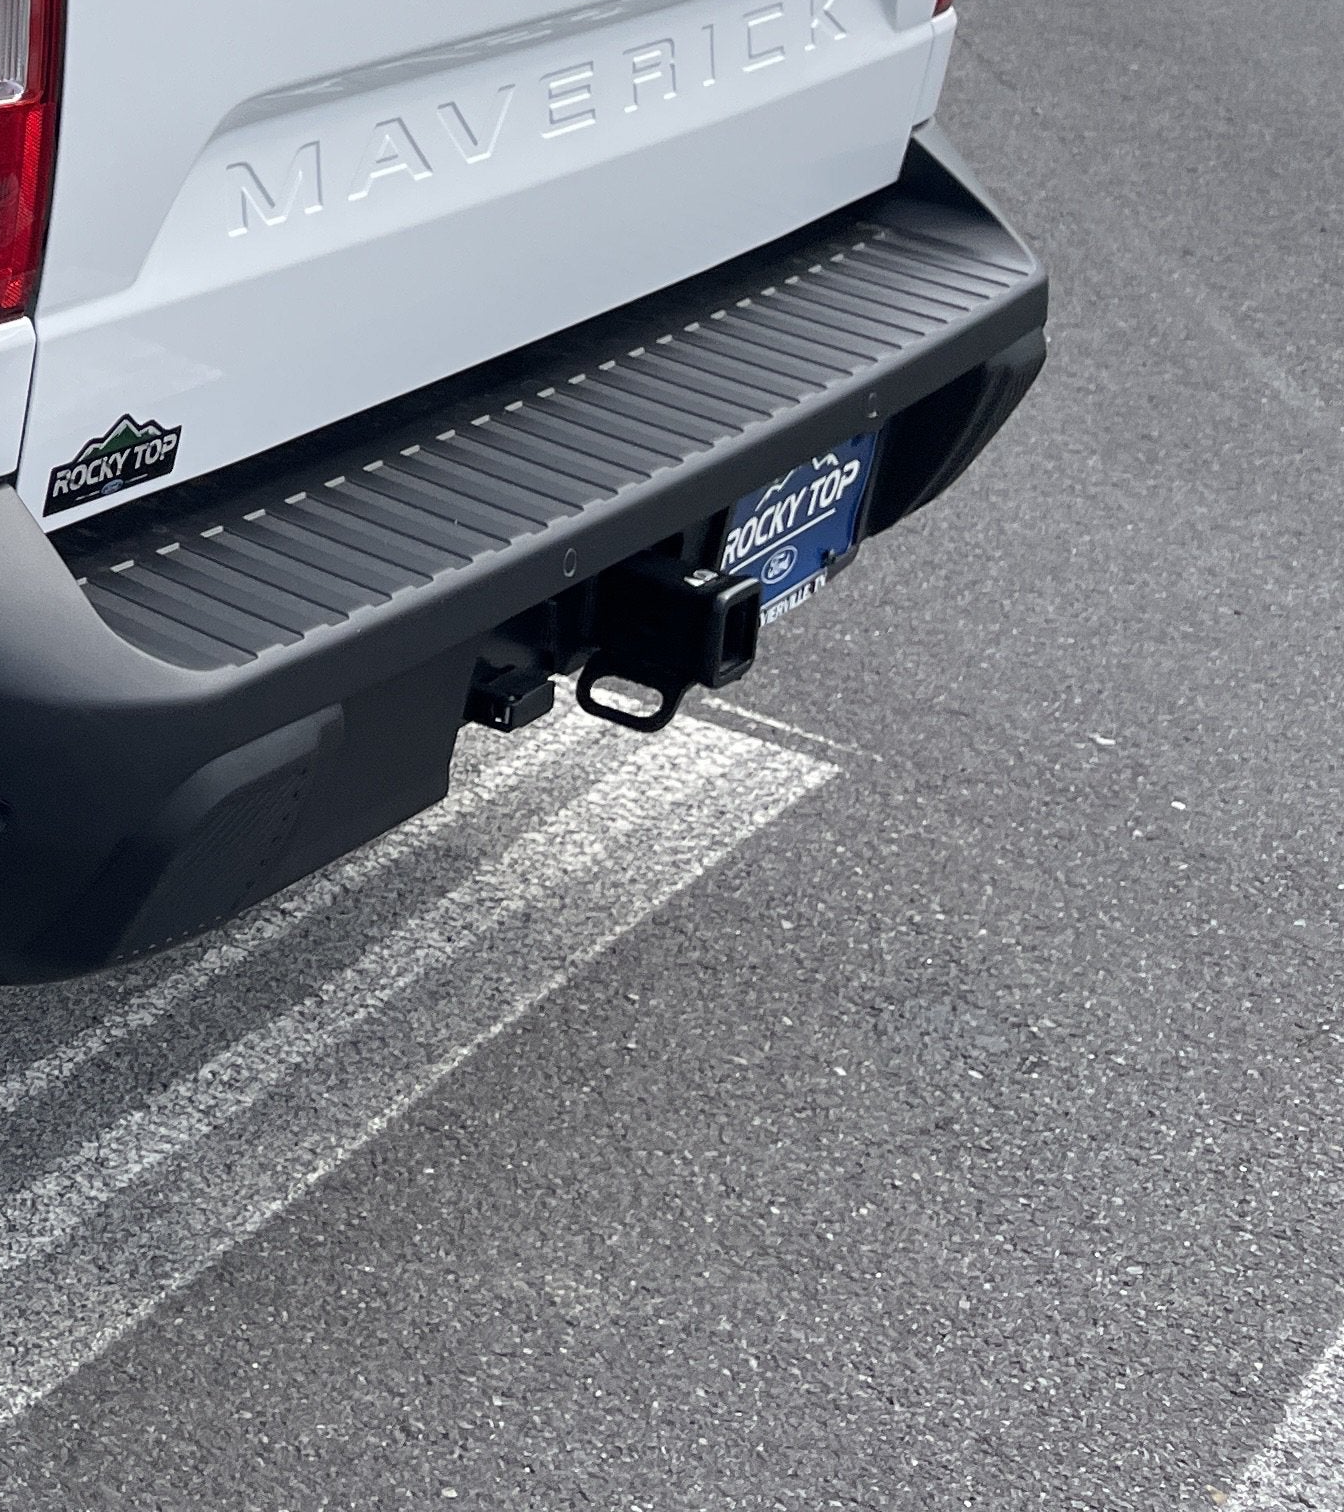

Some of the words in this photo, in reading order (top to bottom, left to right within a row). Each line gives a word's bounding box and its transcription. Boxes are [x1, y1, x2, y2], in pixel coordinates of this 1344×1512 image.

[52, 447, 132, 498] ROCKY
[133, 433, 178, 470] TOP
[720, 486, 808, 571] ROCKY
[808, 459, 861, 517] TOP
